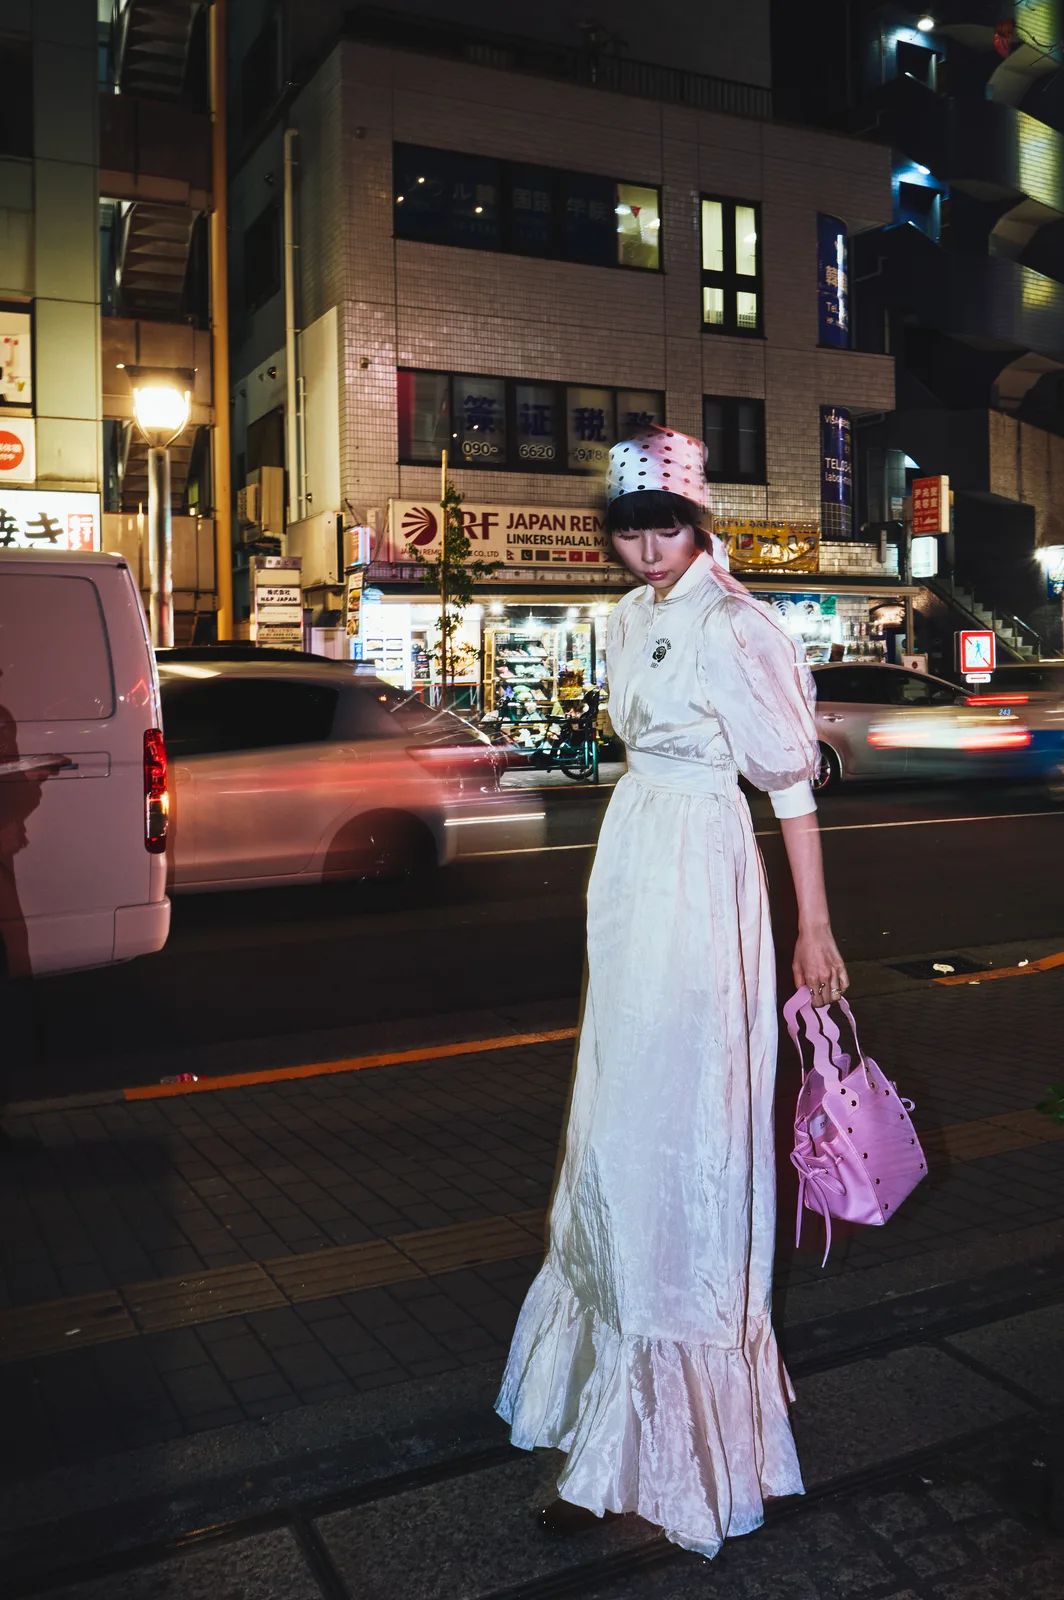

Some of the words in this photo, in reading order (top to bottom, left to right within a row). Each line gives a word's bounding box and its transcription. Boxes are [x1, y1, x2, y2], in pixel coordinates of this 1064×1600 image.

[462, 440, 498, 456] 090-
[519, 444, 554, 460] 6620
[506, 512, 566, 532] JAPAN
[506, 533, 553, 546] LINKERS
[555, 535, 591, 547] HALAL
